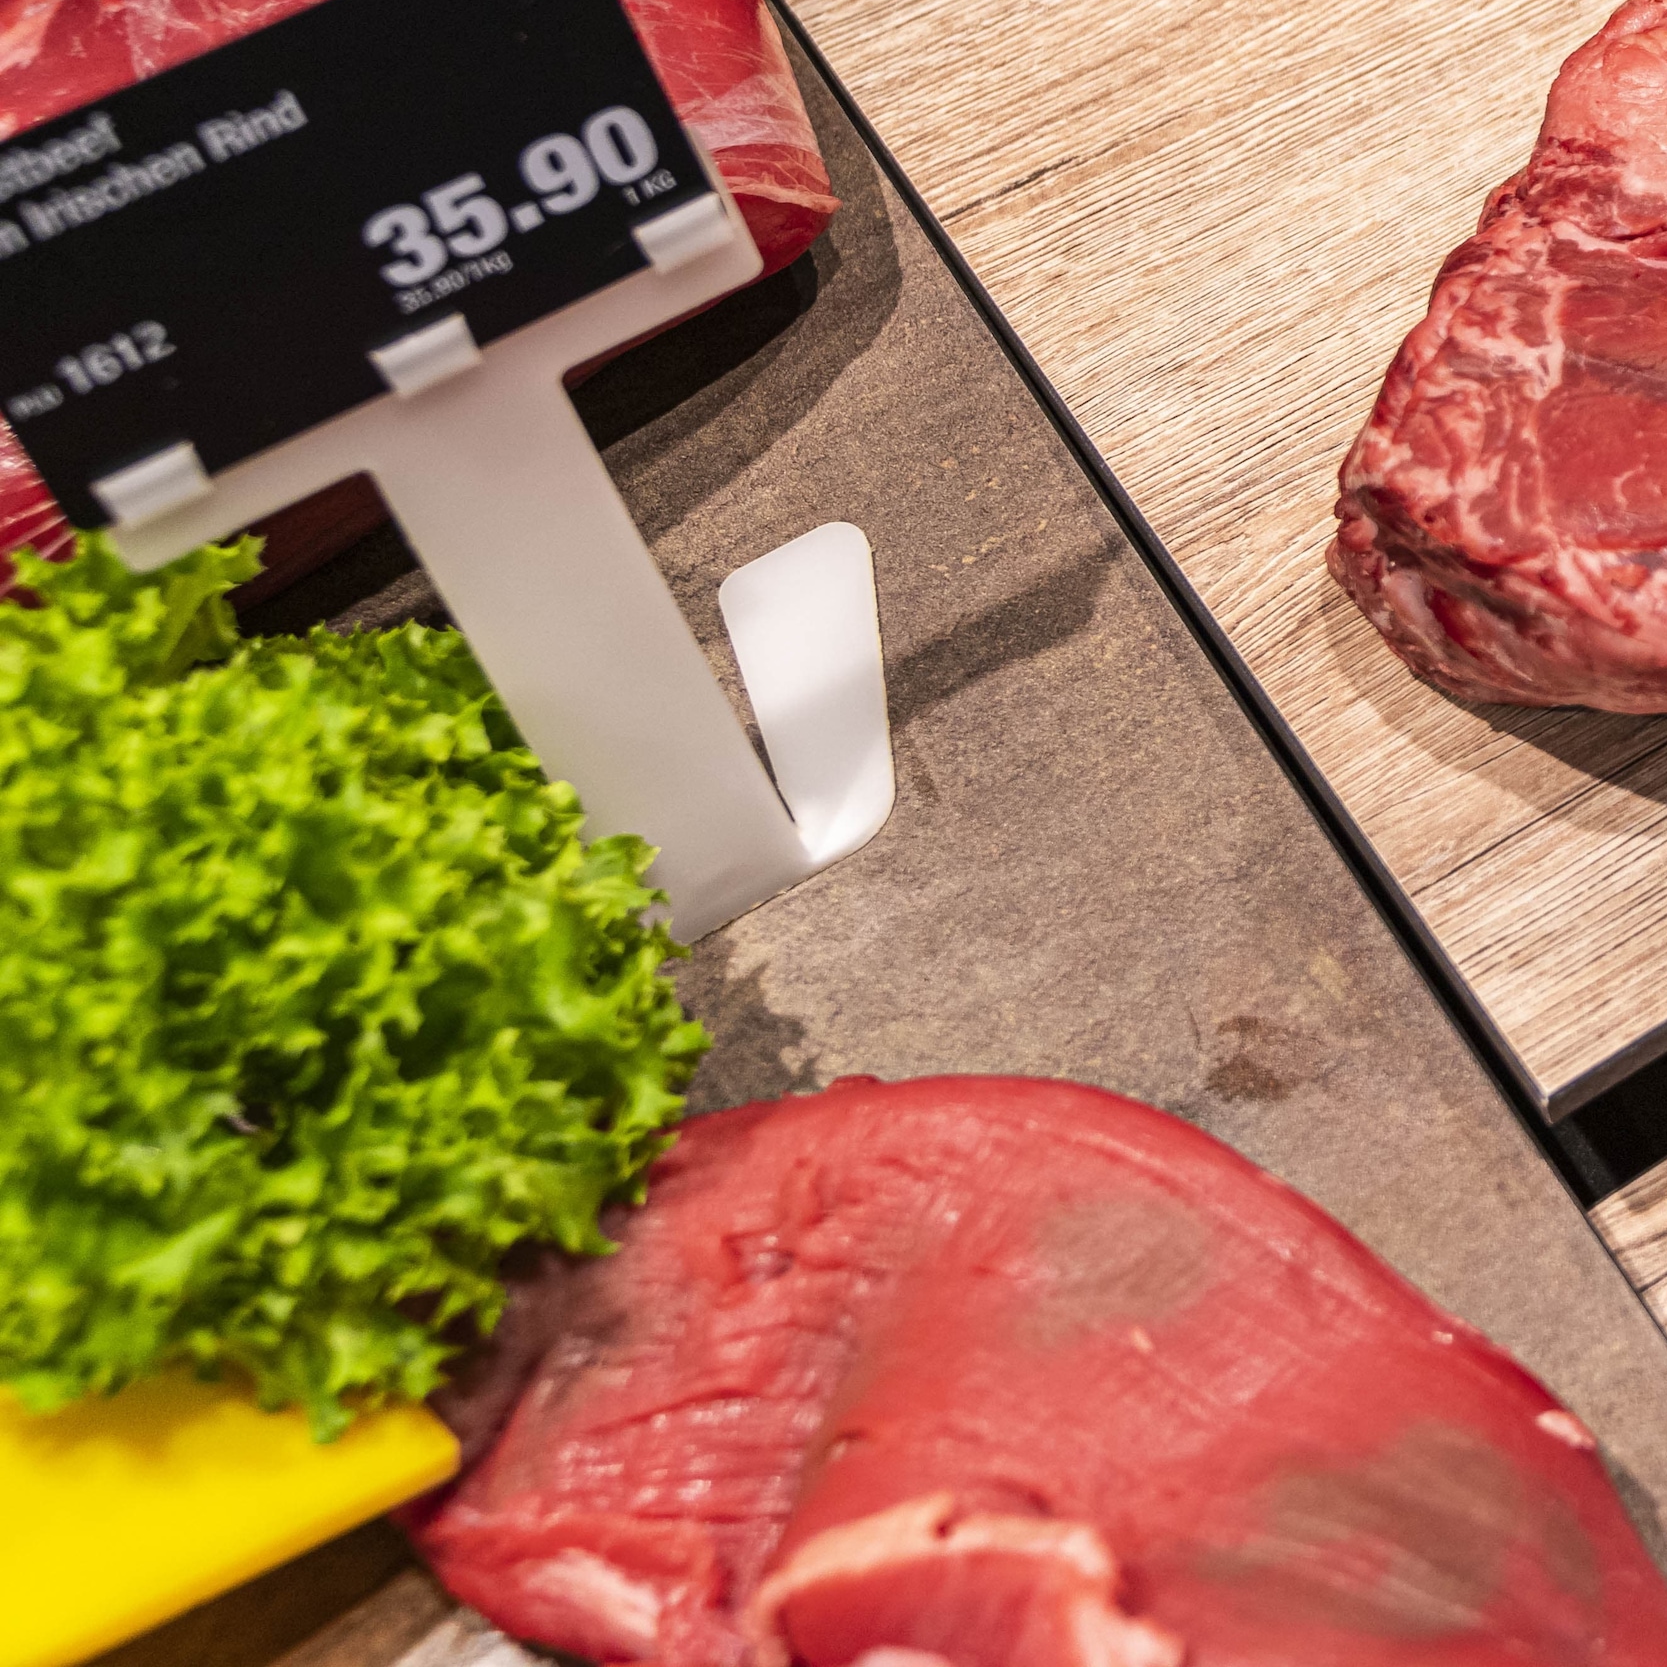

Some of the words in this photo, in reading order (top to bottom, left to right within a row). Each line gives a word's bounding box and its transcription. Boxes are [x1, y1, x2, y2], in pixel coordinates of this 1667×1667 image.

[17, 141, 207, 242] Irischen
[196, 89, 310, 163] Rind
[363, 103, 662, 289] 35.90
[643, 169, 678, 203] KG
[395, 251, 514, 314] 35.90/1kg
[55, 320, 178, 395] 1612
